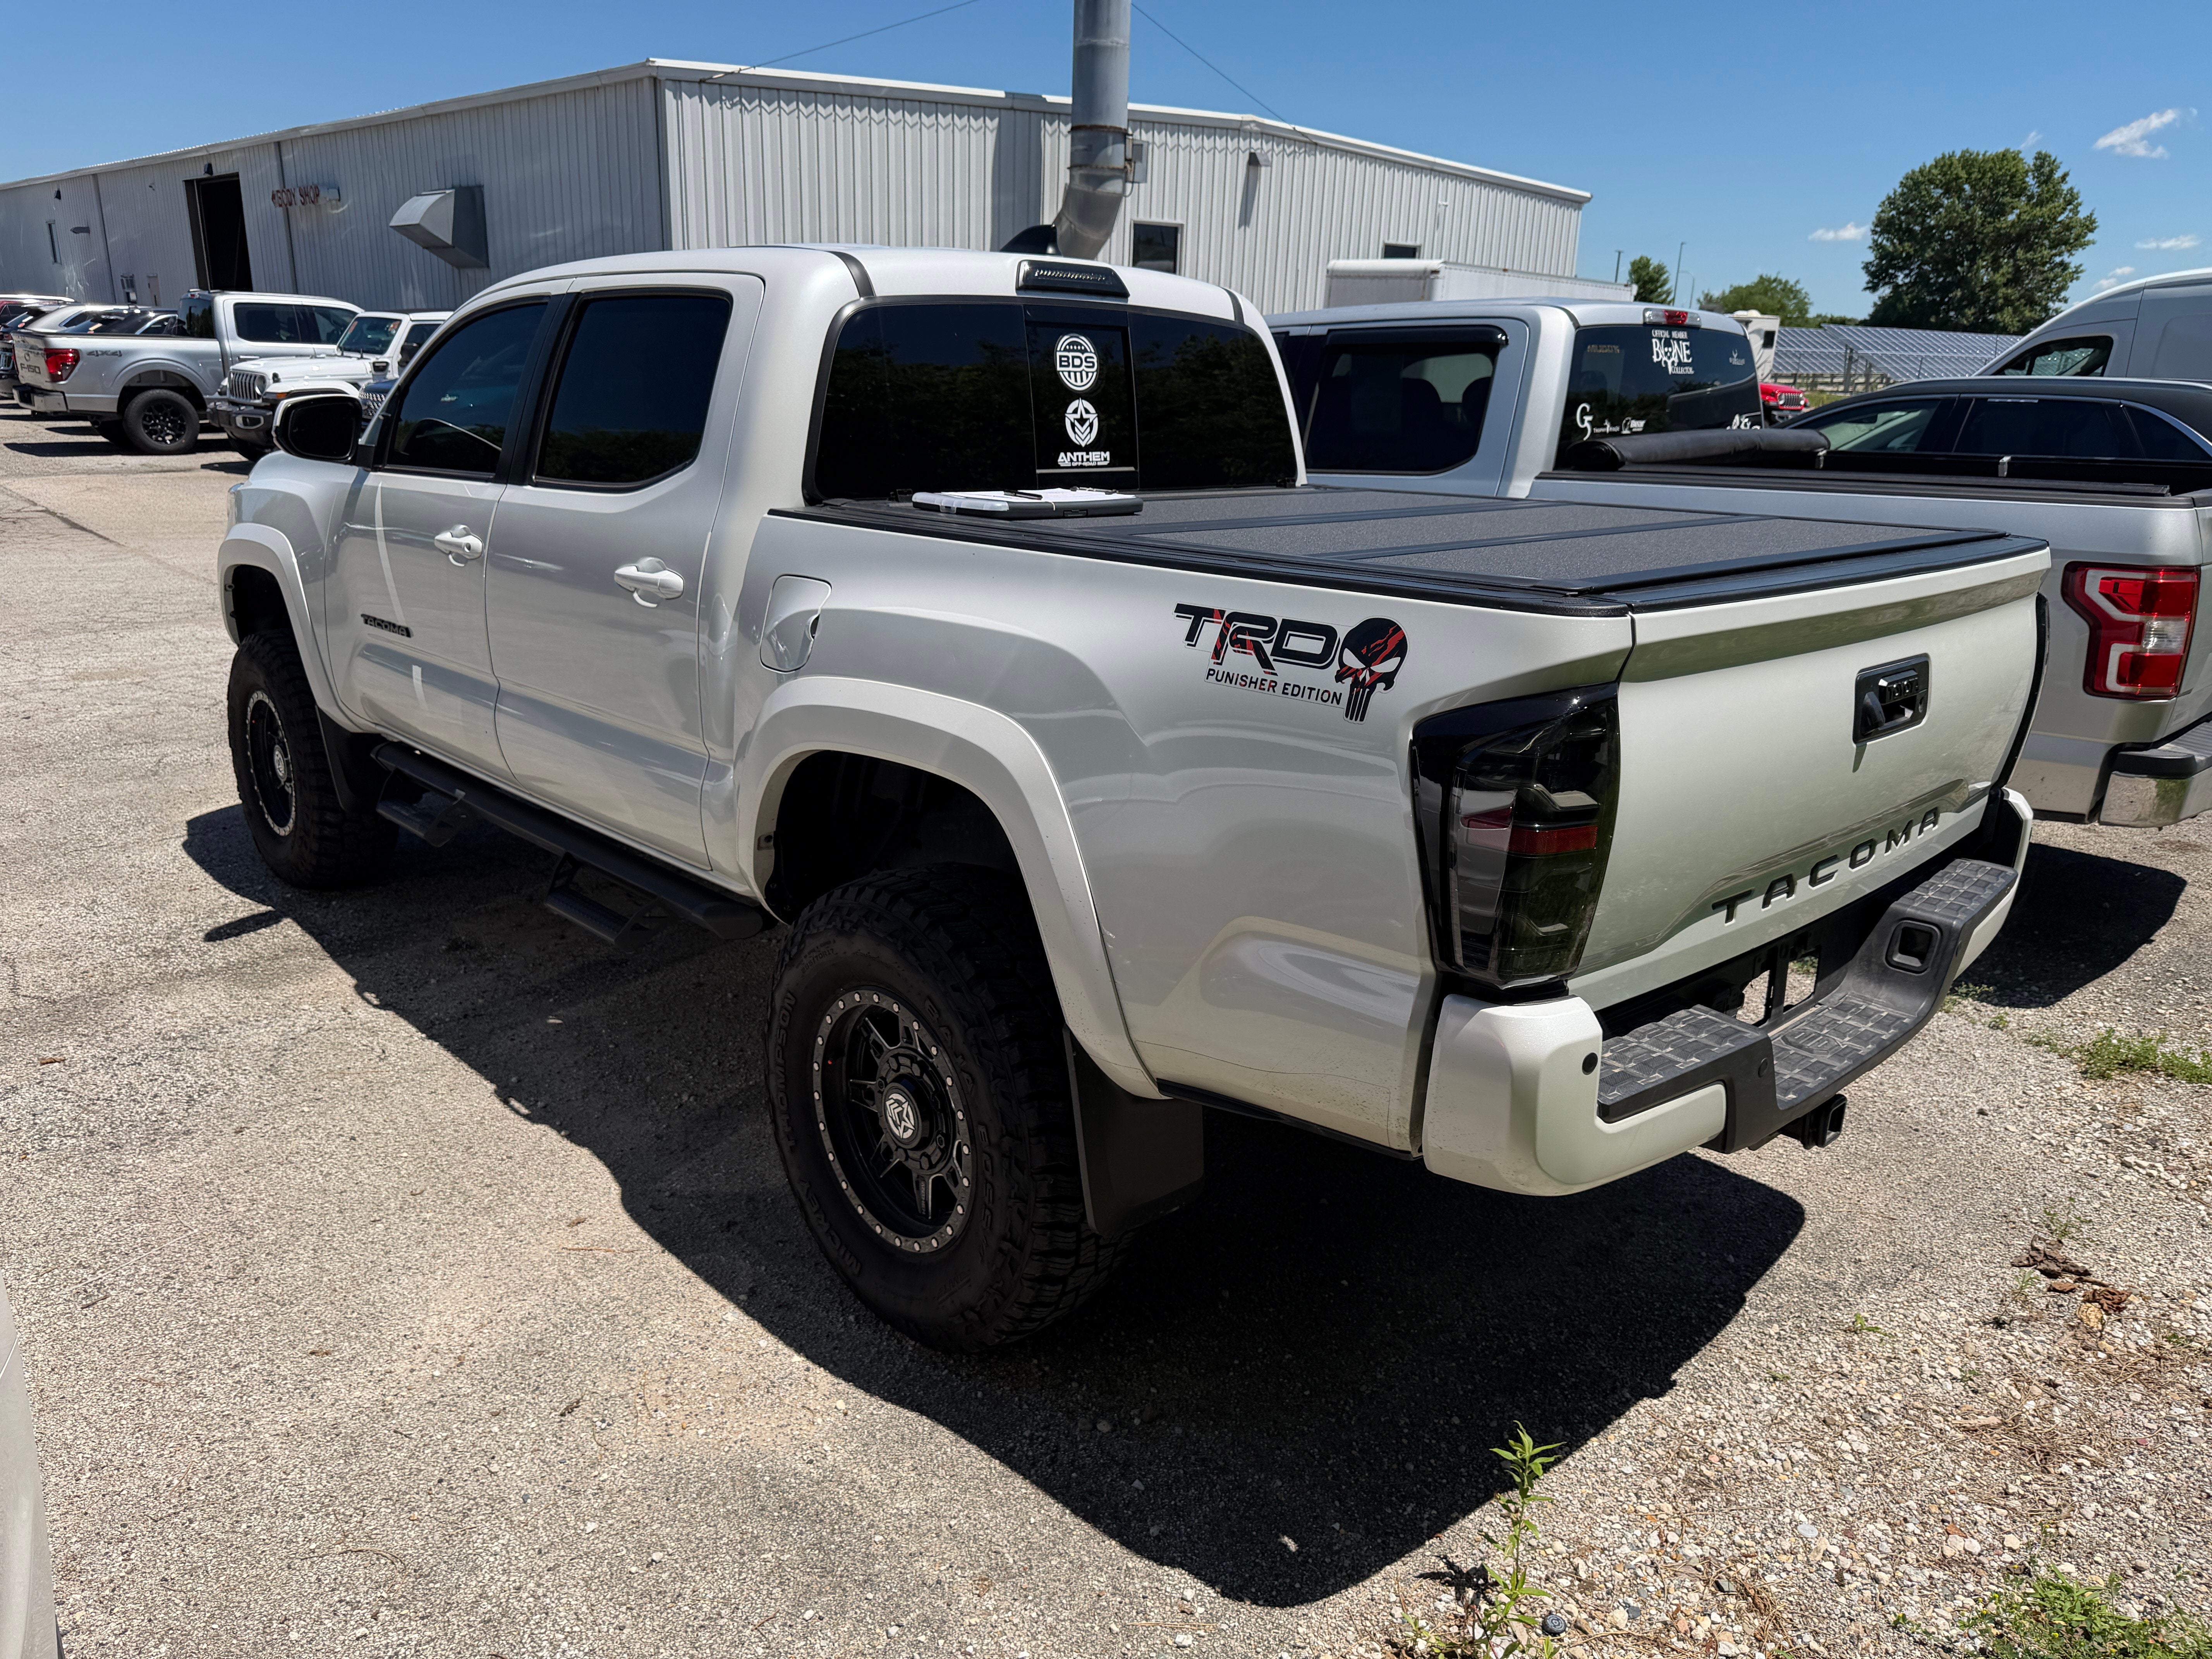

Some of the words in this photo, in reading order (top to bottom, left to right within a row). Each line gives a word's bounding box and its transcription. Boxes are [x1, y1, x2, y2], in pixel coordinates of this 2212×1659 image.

[276, 188, 297, 208] BODY
[299, 185, 320, 206] SHOP
[1652, 328, 1670, 338] OFFICIAL
[20, 362, 41, 374] F-150
[1059, 355, 1096, 368] BDS
[1058, 451, 1110, 464] ANTHEM
[361, 614, 411, 638] TACOMA
[1174, 603, 1341, 676] TRD
[1206, 668, 1278, 693] PUNISHER
[1281, 683, 1342, 705] EDITION
[1711, 807, 1940, 926] TACOMA
